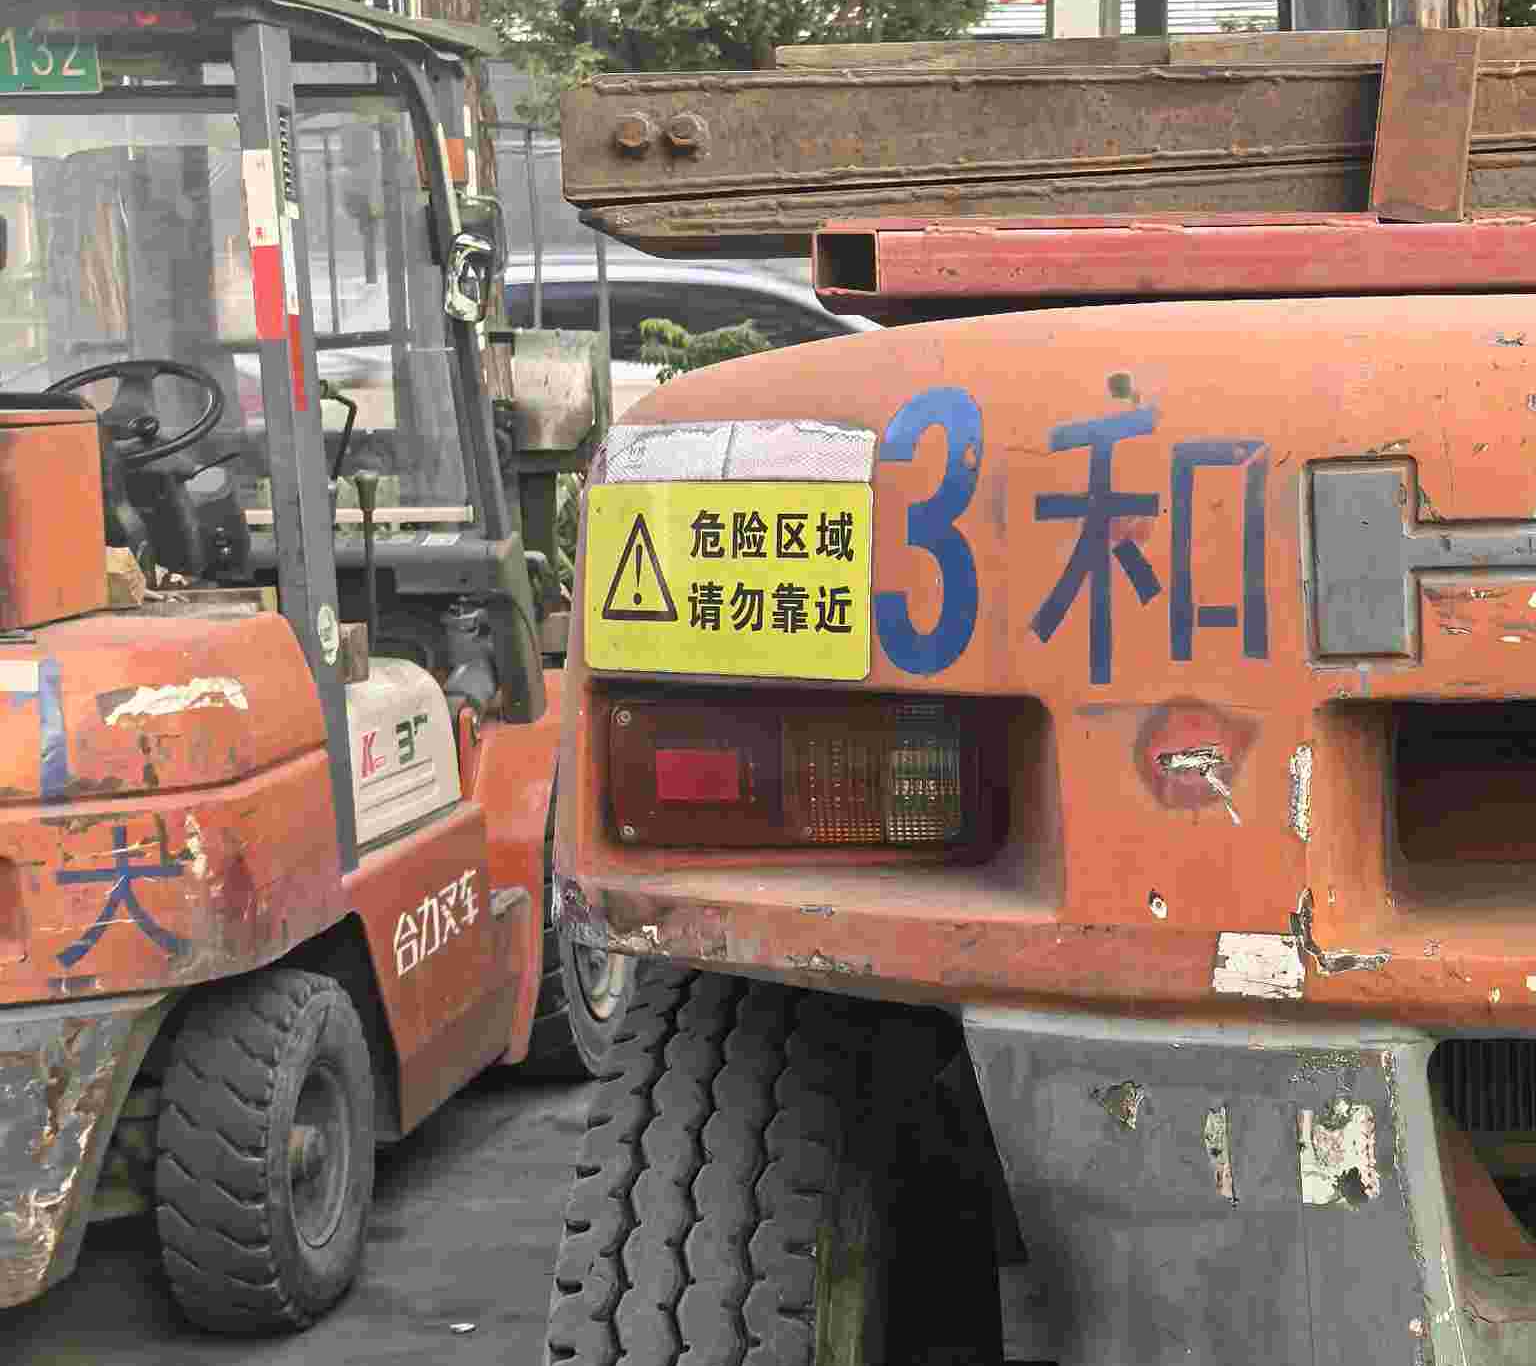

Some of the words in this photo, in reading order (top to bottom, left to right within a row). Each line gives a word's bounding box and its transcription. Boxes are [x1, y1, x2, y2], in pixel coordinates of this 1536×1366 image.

[689, 509, 854, 563] 危险区域
[876, 387, 984, 677] 3
[1029, 403, 1270, 686] 和
[687, 580, 853, 634] 请勿靠近
[56, 825, 190, 968] 大
[392, 867, 480, 977] 合力叉车
